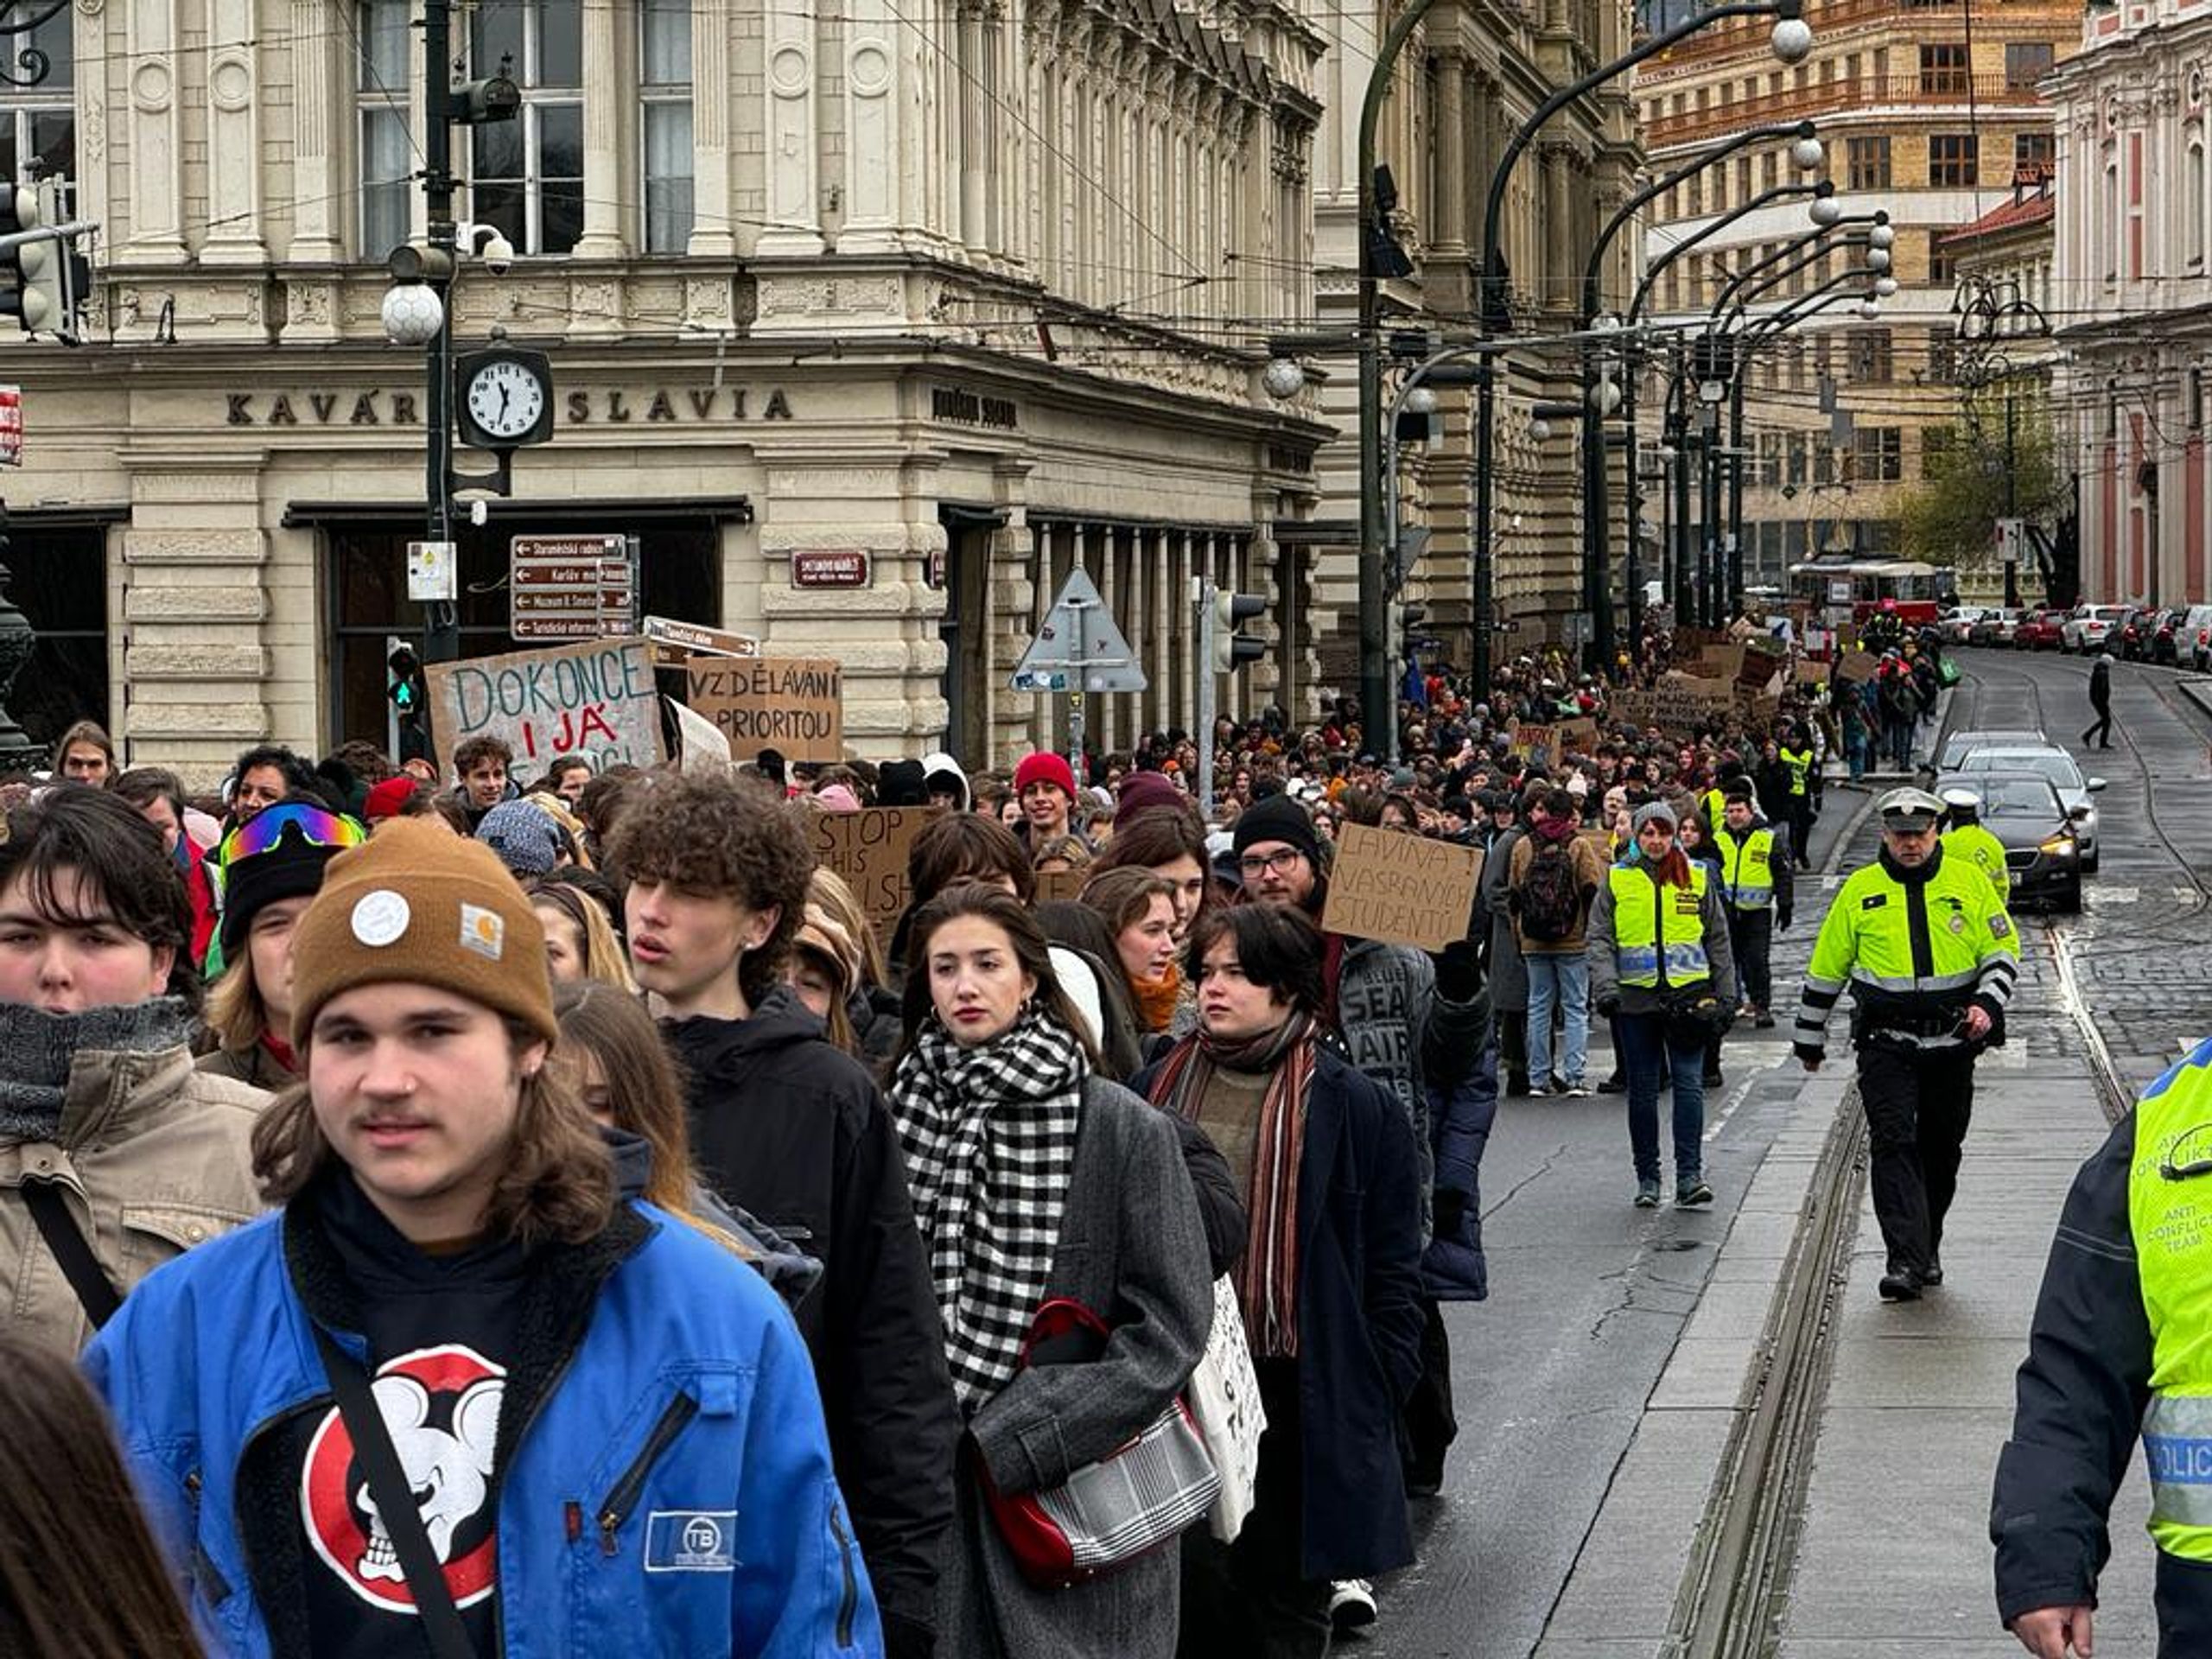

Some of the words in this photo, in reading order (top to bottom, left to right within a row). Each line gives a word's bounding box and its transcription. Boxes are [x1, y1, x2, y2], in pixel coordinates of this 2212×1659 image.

[568, 390, 792, 423] SLAVIA
[452, 643, 659, 733] DOKONCE
[690, 663, 841, 699] VZDĚLÁVÁNÍ
[523, 721, 537, 758] I
[552, 702, 617, 753] JÁ
[716, 709, 831, 740] PRIORITOU
[817, 810, 903, 850] STOP
[812, 849, 867, 874] THIS
[1341, 827, 1449, 871] LAVINA
[1344, 985, 1407, 1026] SEA
[1358, 1030, 1412, 1065] AIR
[690, 1529, 715, 1548] TB
